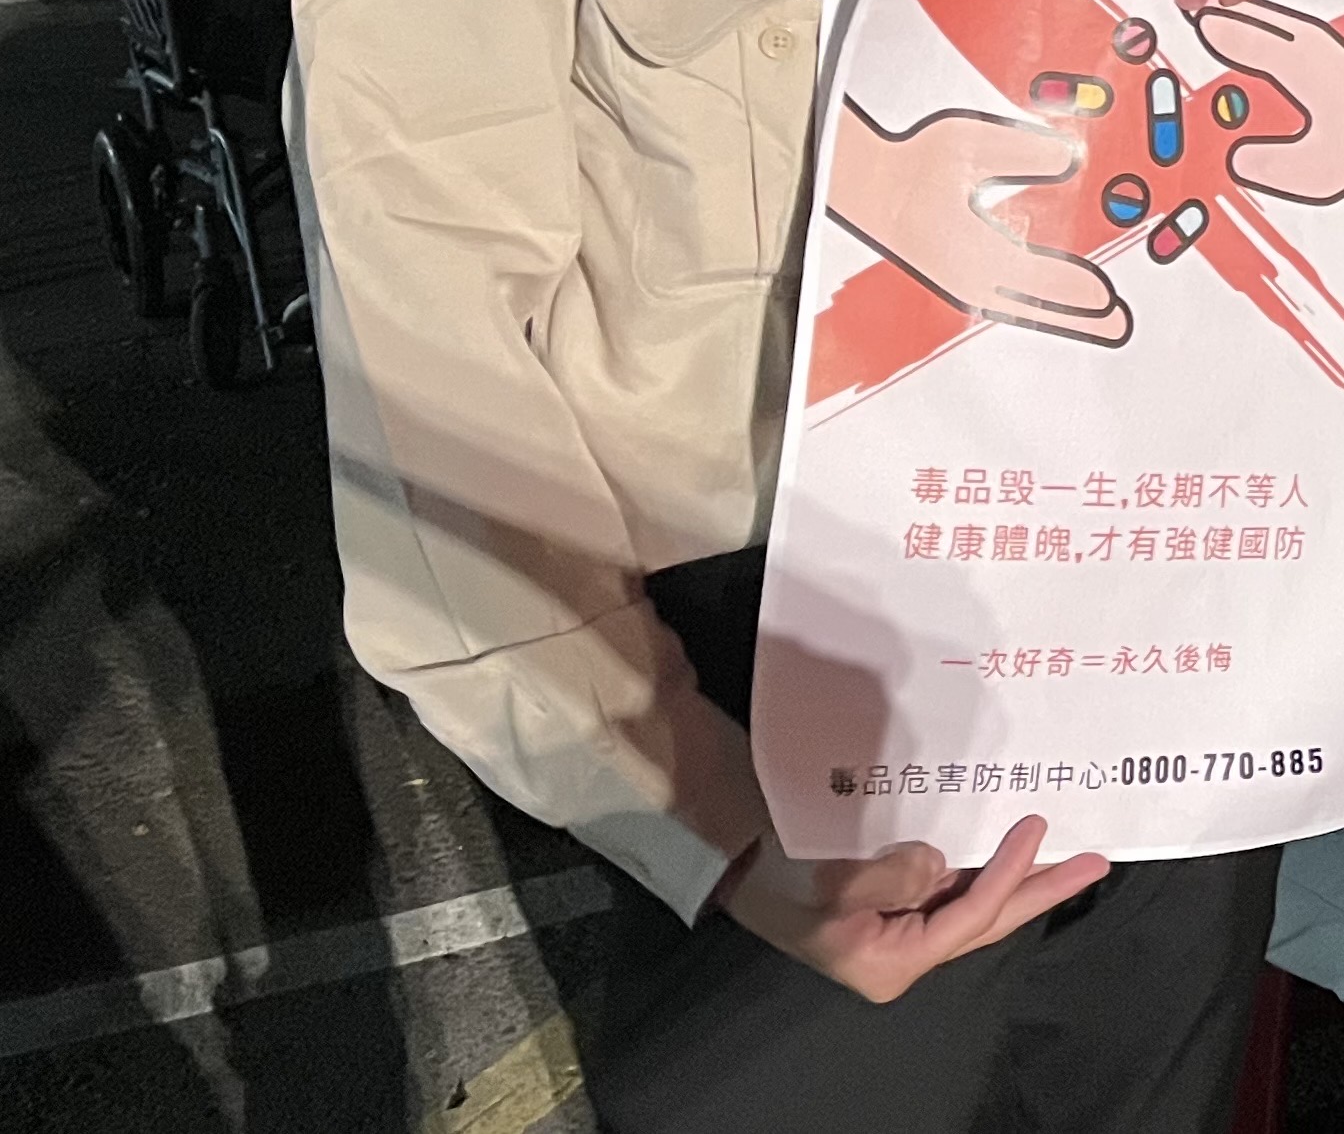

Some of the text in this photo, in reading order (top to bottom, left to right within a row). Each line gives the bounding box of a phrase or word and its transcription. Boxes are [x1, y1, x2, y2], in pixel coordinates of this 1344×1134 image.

[910, 466, 1309, 510] 毒品毀一生,役期不等人
[902, 521, 1307, 564] 健康體魄,才有強健國防
